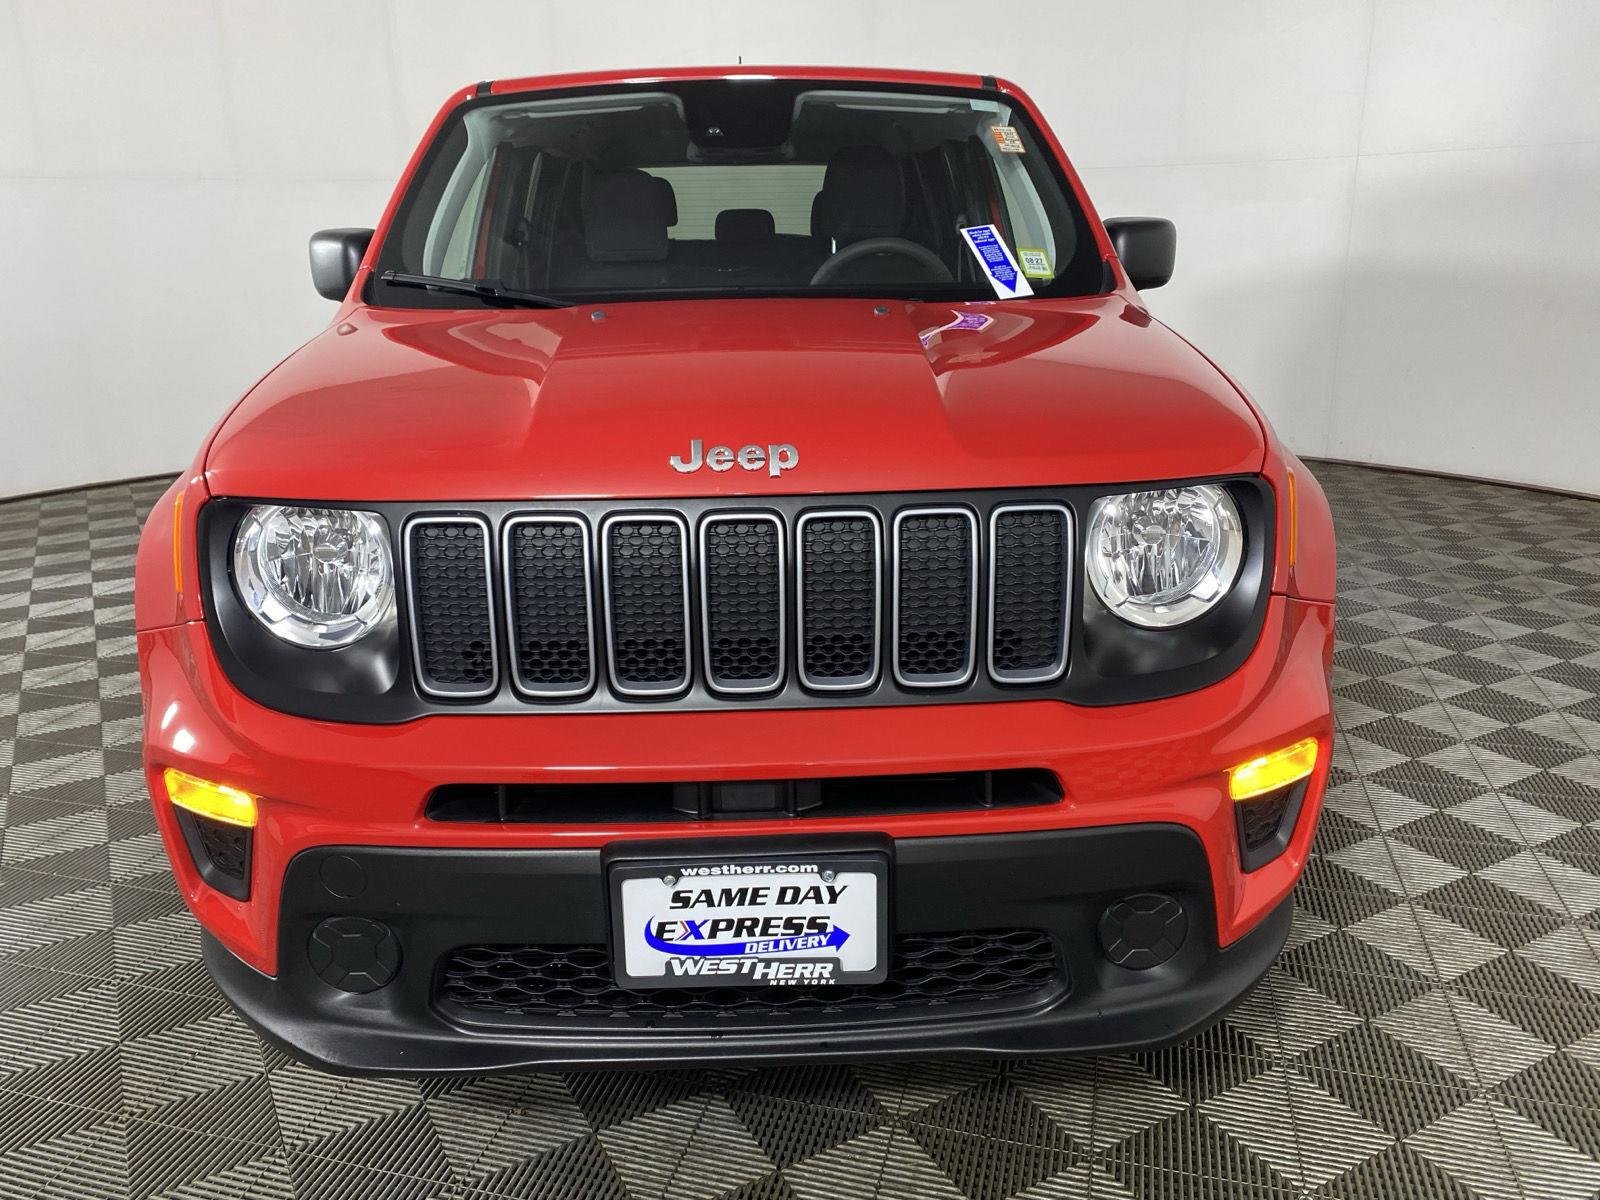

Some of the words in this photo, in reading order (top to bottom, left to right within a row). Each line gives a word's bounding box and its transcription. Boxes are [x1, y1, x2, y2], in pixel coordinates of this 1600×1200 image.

[670, 439, 799, 478] Jeep
[680, 864, 818, 876] westherr.com
[669, 886, 769, 910] SAME
[776, 885, 849, 906] DAY
[655, 915, 831, 941] EXPRESS
[744, 933, 832, 954] DELIVERY
